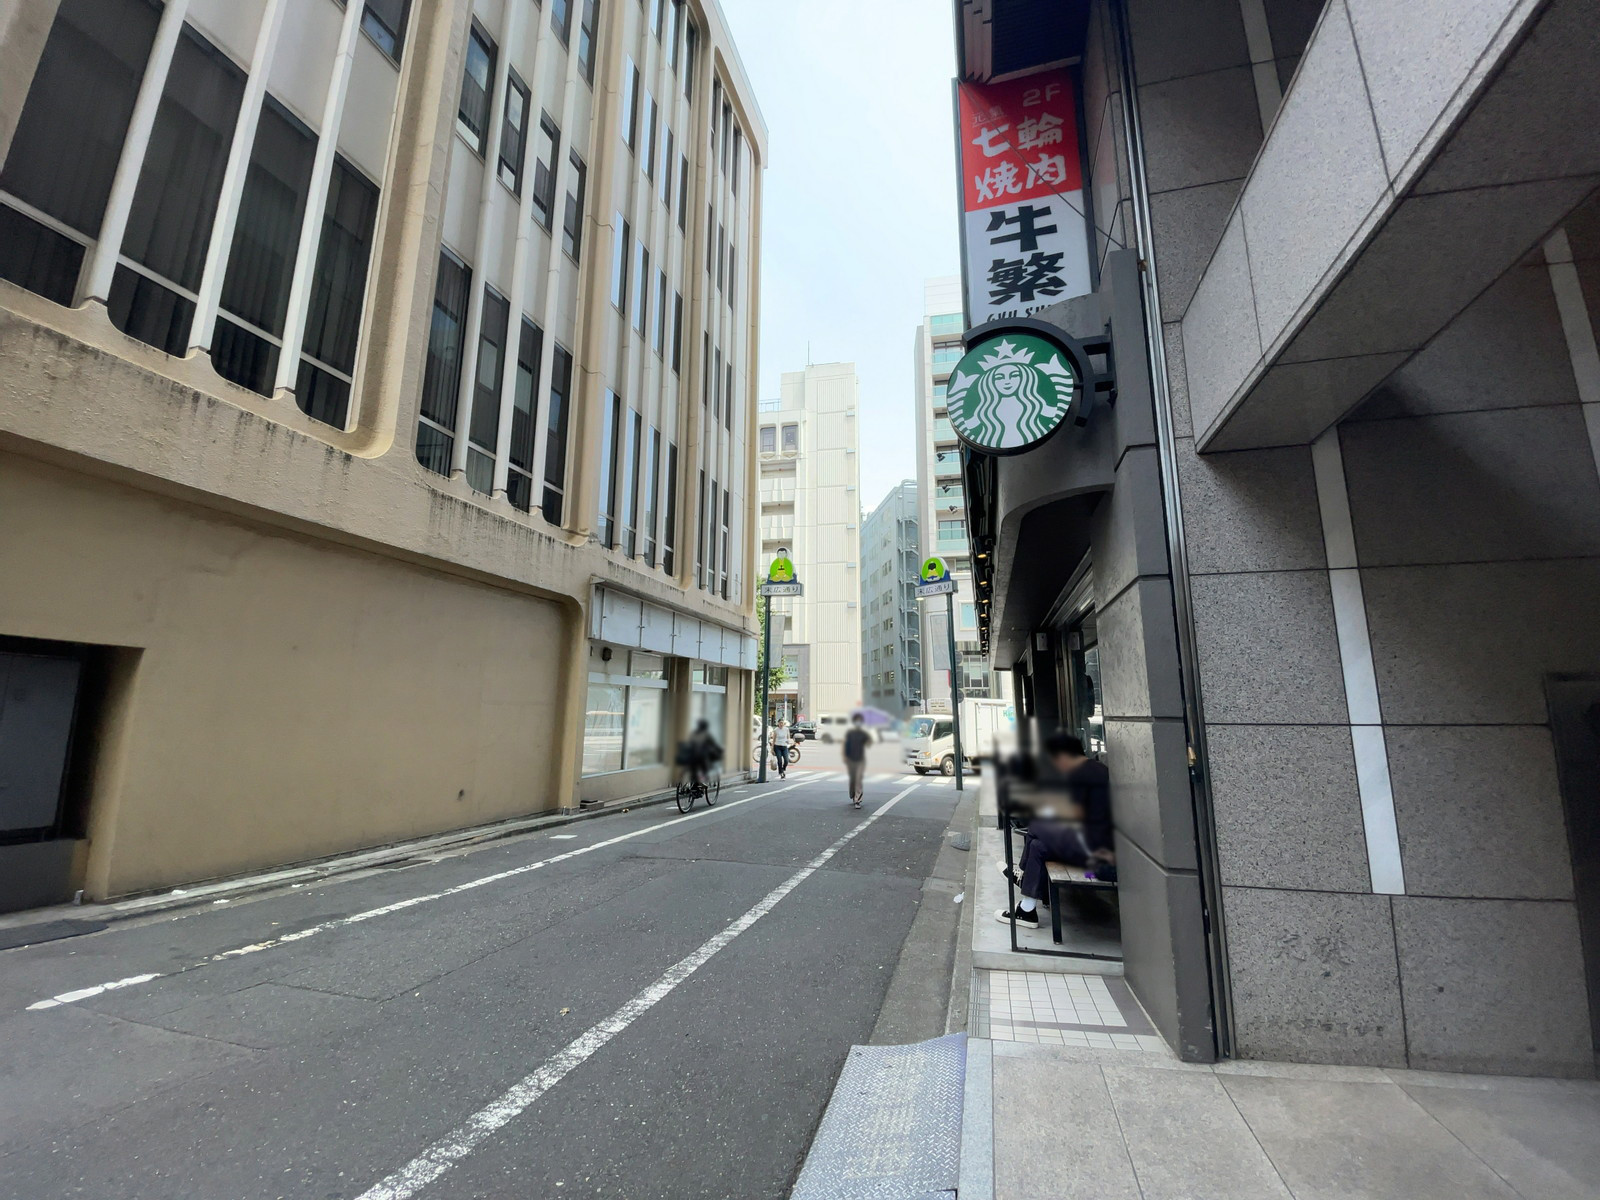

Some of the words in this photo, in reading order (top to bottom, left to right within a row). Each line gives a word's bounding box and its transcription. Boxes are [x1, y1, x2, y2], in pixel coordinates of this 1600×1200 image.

[1023, 83, 1061, 107] 2F
[971, 112, 1064, 157] 七輪
[974, 153, 1066, 203] 焼肉
[985, 204, 1067, 305] 牛繁
